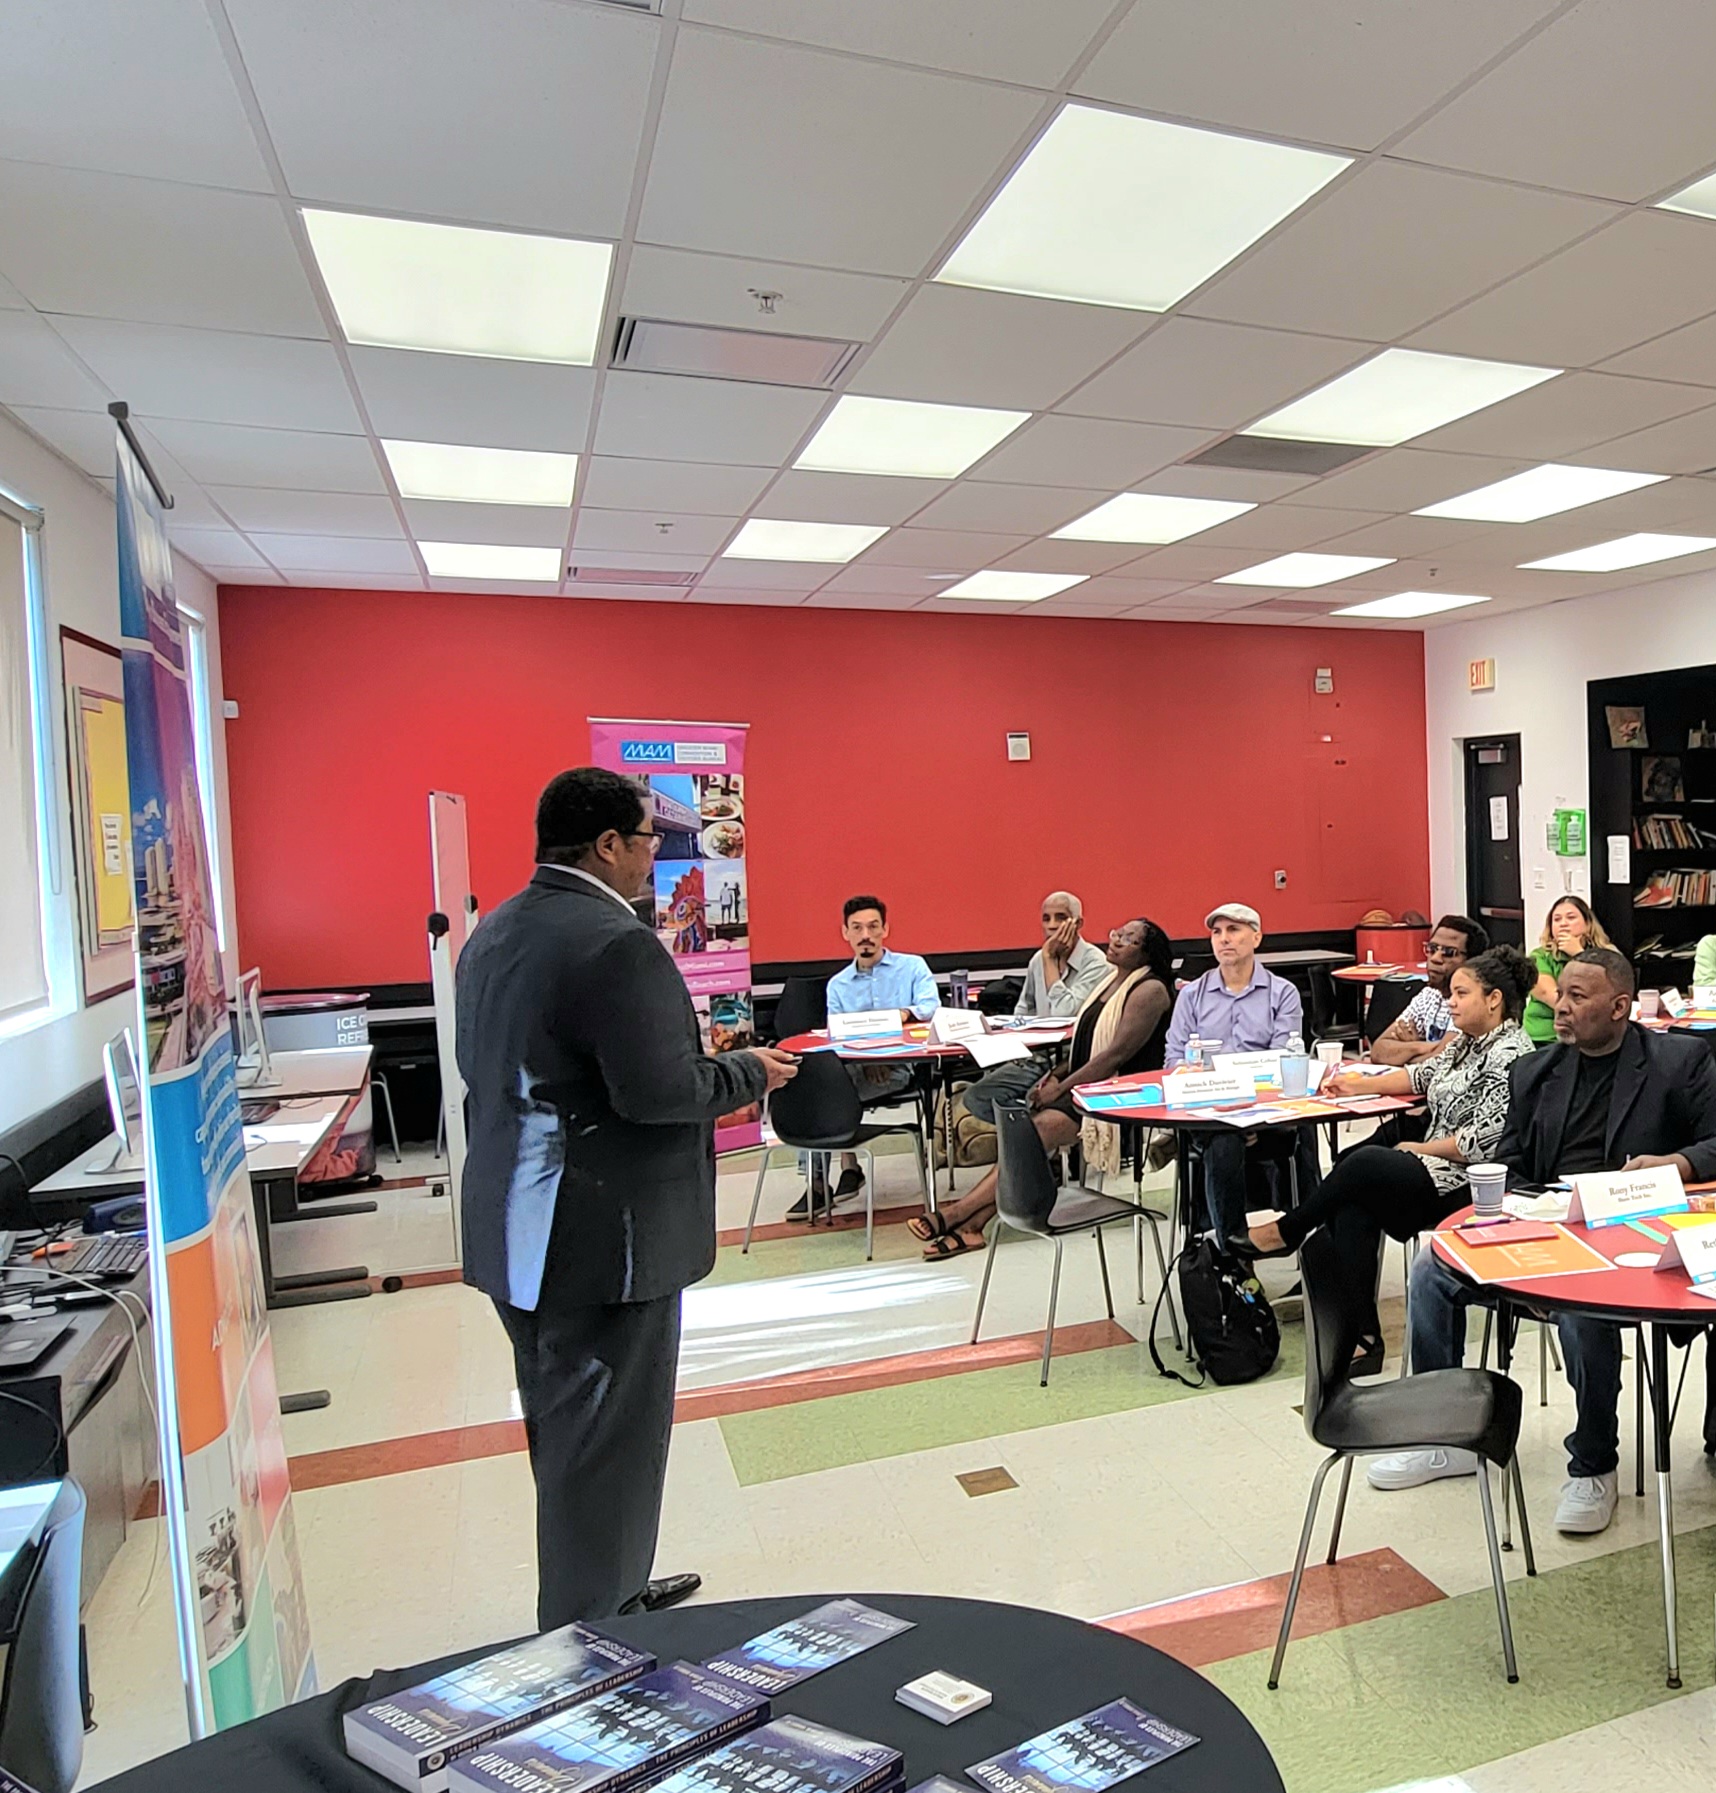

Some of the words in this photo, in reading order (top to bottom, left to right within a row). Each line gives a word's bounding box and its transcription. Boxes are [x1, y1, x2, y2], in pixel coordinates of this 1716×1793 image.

[1470, 660, 1486, 687] EXIT
[337, 1016, 357, 1031] ICE
[338, 1029, 366, 1045] REF
[1630, 1181, 1656, 1193] Francis
[604, 1666, 645, 1689] LEADERSHIP
[707, 1661, 788, 1690] LEADERSHIP
[370, 1703, 449, 1747] LEADERSHIP
[717, 1709, 758, 1733] LEADERSHIP
[471, 1753, 562, 1793] EADERSHIP
[978, 1764, 1031, 1793] ERSHIP
